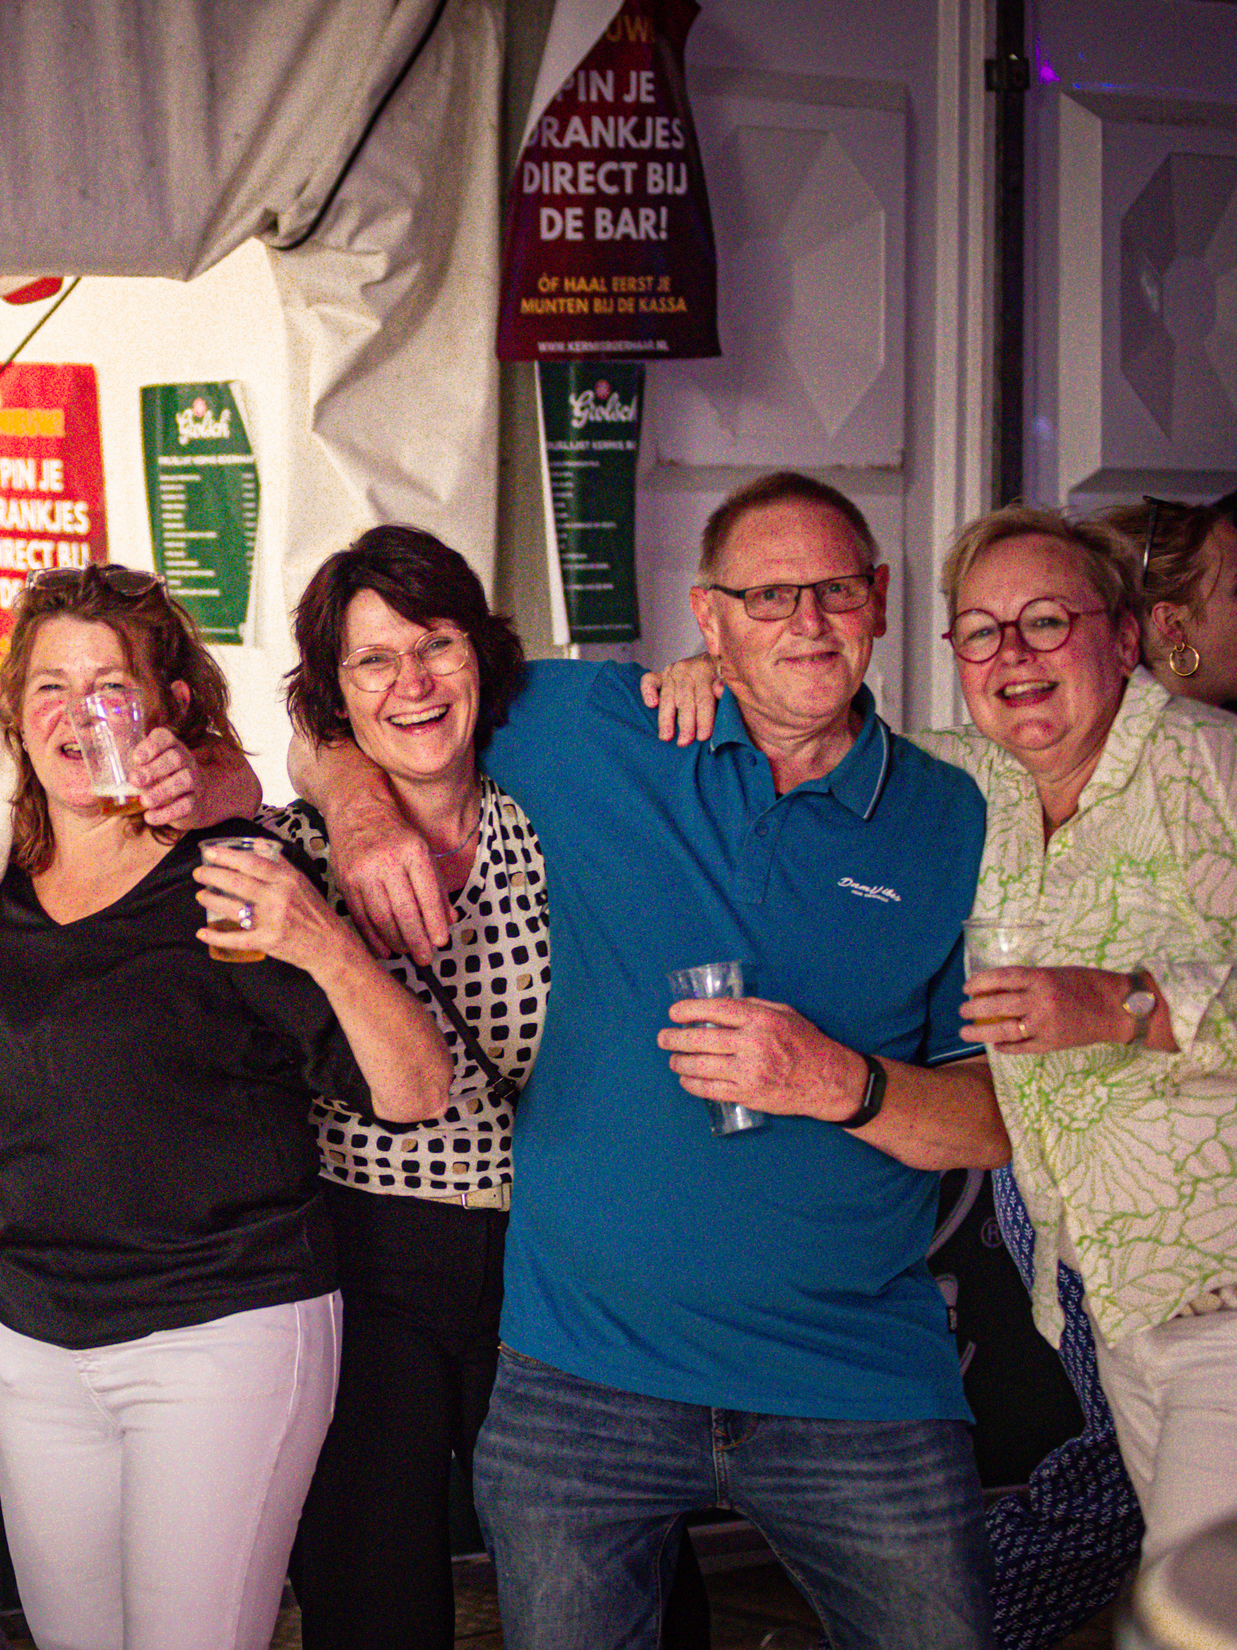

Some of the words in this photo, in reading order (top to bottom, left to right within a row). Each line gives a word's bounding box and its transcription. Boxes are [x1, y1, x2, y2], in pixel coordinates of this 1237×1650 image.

[622, 70, 655, 103] JE
[523, 161, 638, 195] DIRECT
[646, 161, 688, 195] BIJ
[539, 207, 584, 240] DE
[594, 206, 668, 241] BAR!
[564, 276, 608, 293] HAAL
[612, 275, 654, 293] EERST
[656, 275, 671, 293] JE
[520, 298, 589, 315] MUNTEN
[593, 298, 614, 314] BIJ
[617, 297, 635, 313] DE
[638, 296, 688, 313] KASSA
[39, 458, 63, 492] JE
[57, 541, 90, 570] BIJ
